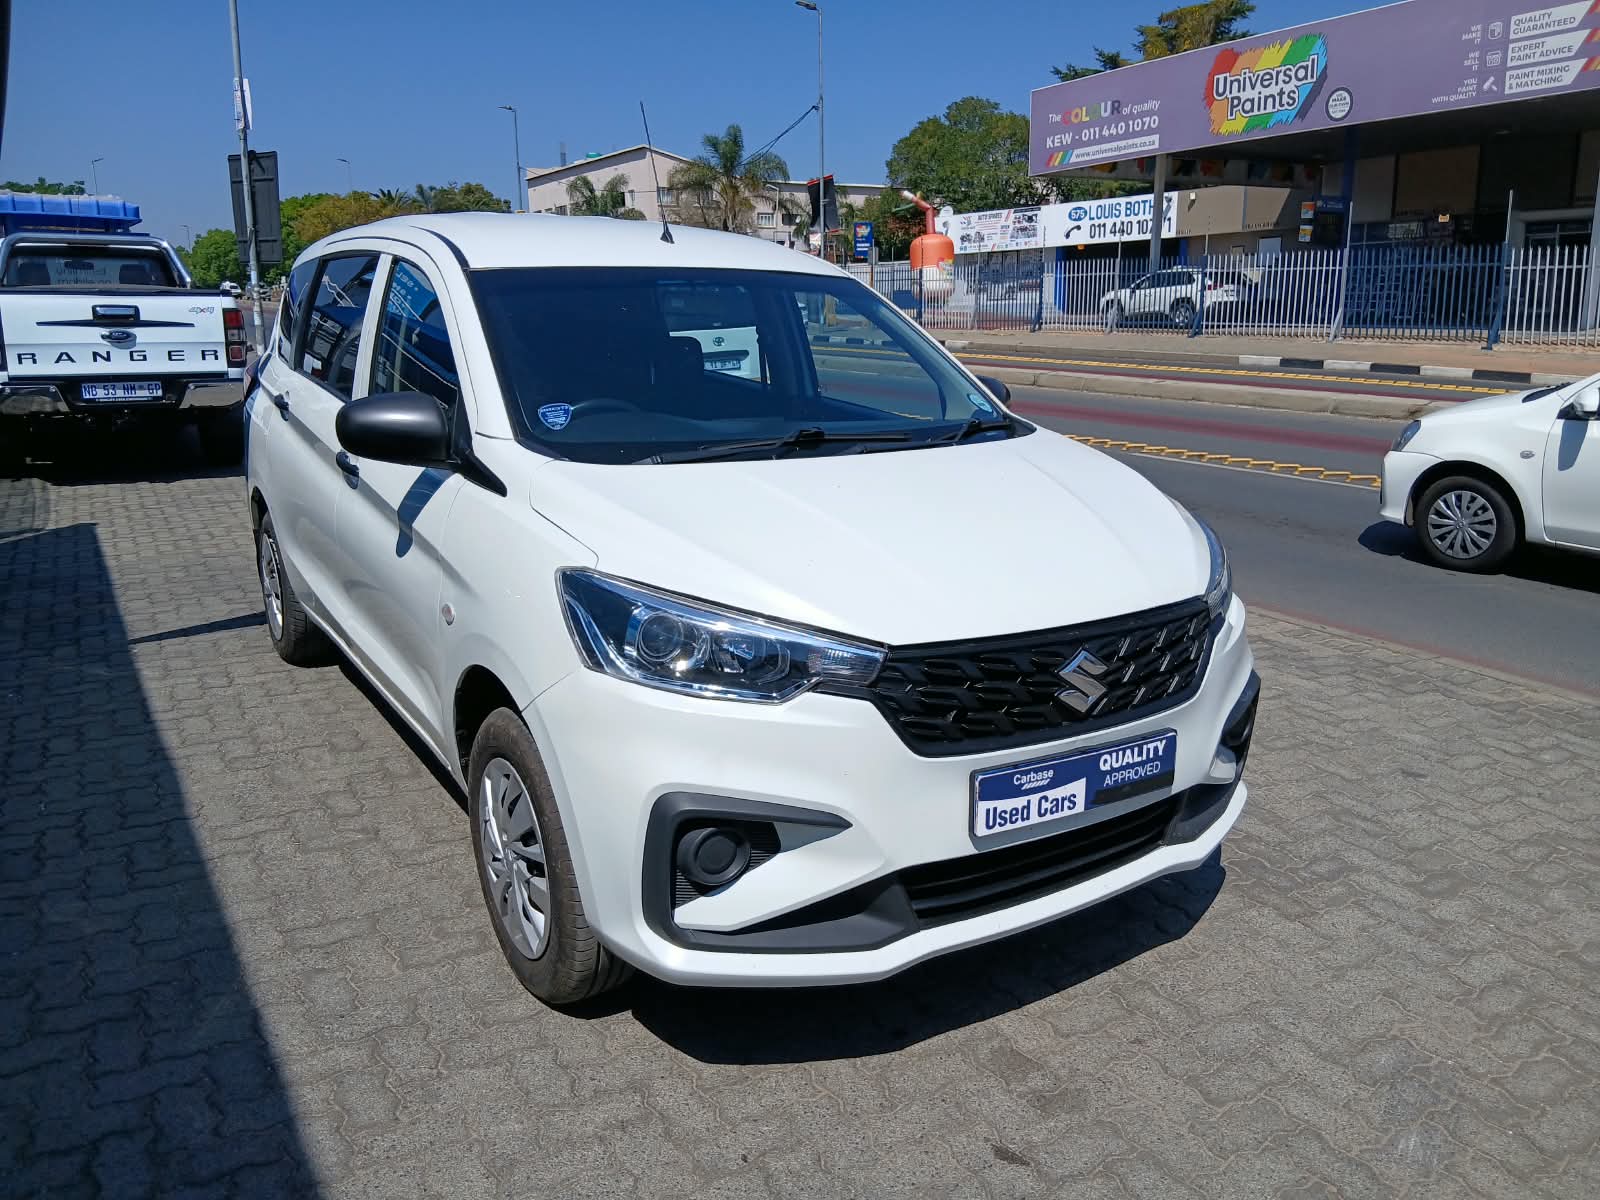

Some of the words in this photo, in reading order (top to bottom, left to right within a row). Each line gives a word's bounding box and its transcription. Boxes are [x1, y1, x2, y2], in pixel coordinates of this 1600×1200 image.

[1513, 17, 1576, 35] GUARANTEED
[1514, 12, 1552, 26] QUALITY
[1510, 52, 1537, 63] PAINT
[1539, 45, 1574, 58] ADVICE
[1511, 41, 1547, 54] EXPERT
[1214, 58, 1316, 98] Universal
[1463, 77, 1478, 86] YOU
[1509, 70, 1538, 81] PAINT
[1540, 65, 1570, 77] MIXING
[1509, 82, 1514, 90] &
[1516, 75, 1563, 89] MATCHING
[1229, 87, 1299, 119] Paints
[1432, 95, 1448, 104] WITH
[1449, 91, 1476, 102] QUALITY
[1049, 113, 1062, 124] The
[1062, 100, 1121, 126] COLOUR
[1122, 103, 1131, 115] of
[1132, 99, 1160, 113] quality
[1046, 132, 1072, 149] KEW
[1082, 127, 1099, 141] 011
[1102, 122, 1125, 137] 440
[1128, 115, 1159, 133] 1070
[1075, 139, 1156, 159] www.universalpaints.co.za
[1071, 210, 1085, 219] 575
[1089, 202, 1121, 221] LOUIS
[1089, 222, 1106, 239] 011
[1110, 221, 1133, 237] 440
[17, 350, 219, 365] RANGER
[103, 383, 117, 396] 53
[147, 382, 161, 395] GP
[1099, 739, 1166, 772] QUALITY
[1014, 769, 1054, 786] Carbase
[1104, 761, 1161, 788] APPROVED
[985, 798, 1031, 830] Used
[1037, 791, 1077, 819] Cars
